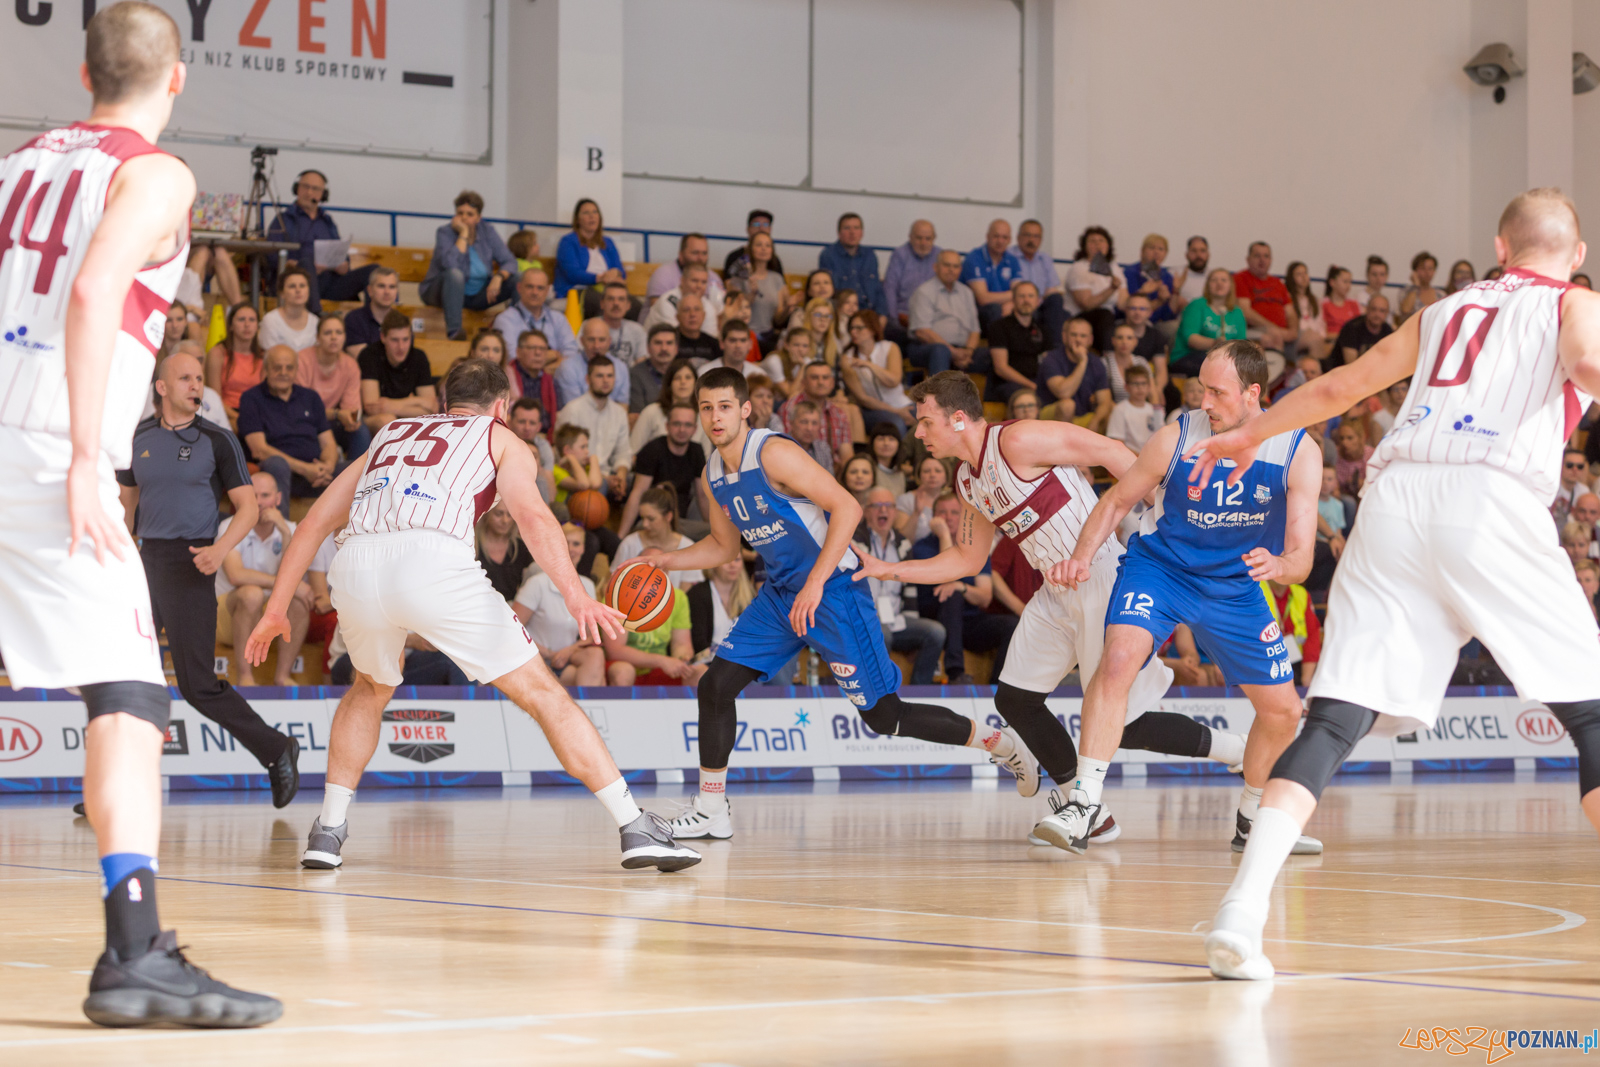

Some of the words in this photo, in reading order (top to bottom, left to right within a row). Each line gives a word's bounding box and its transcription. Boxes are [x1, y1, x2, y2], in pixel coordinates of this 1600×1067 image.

[242, 55, 286, 73] KLUB
[295, 59, 388, 82] SPORTOWY
[586, 146, 604, 172] B
[1427, 303, 1500, 387] 0
[365, 419, 470, 476] 25
[993, 486, 1011, 509] 10
[1212, 480, 1244, 507] 12
[732, 495, 751, 521] 0
[1187, 508, 1265, 525] BIOFARM
[638, 574, 663, 610] molten
[1123, 592, 1154, 615] 12
[832, 664, 852, 675] KIA
[392, 725, 448, 742] JOKER
[1523, 716, 1560, 737] KIA
